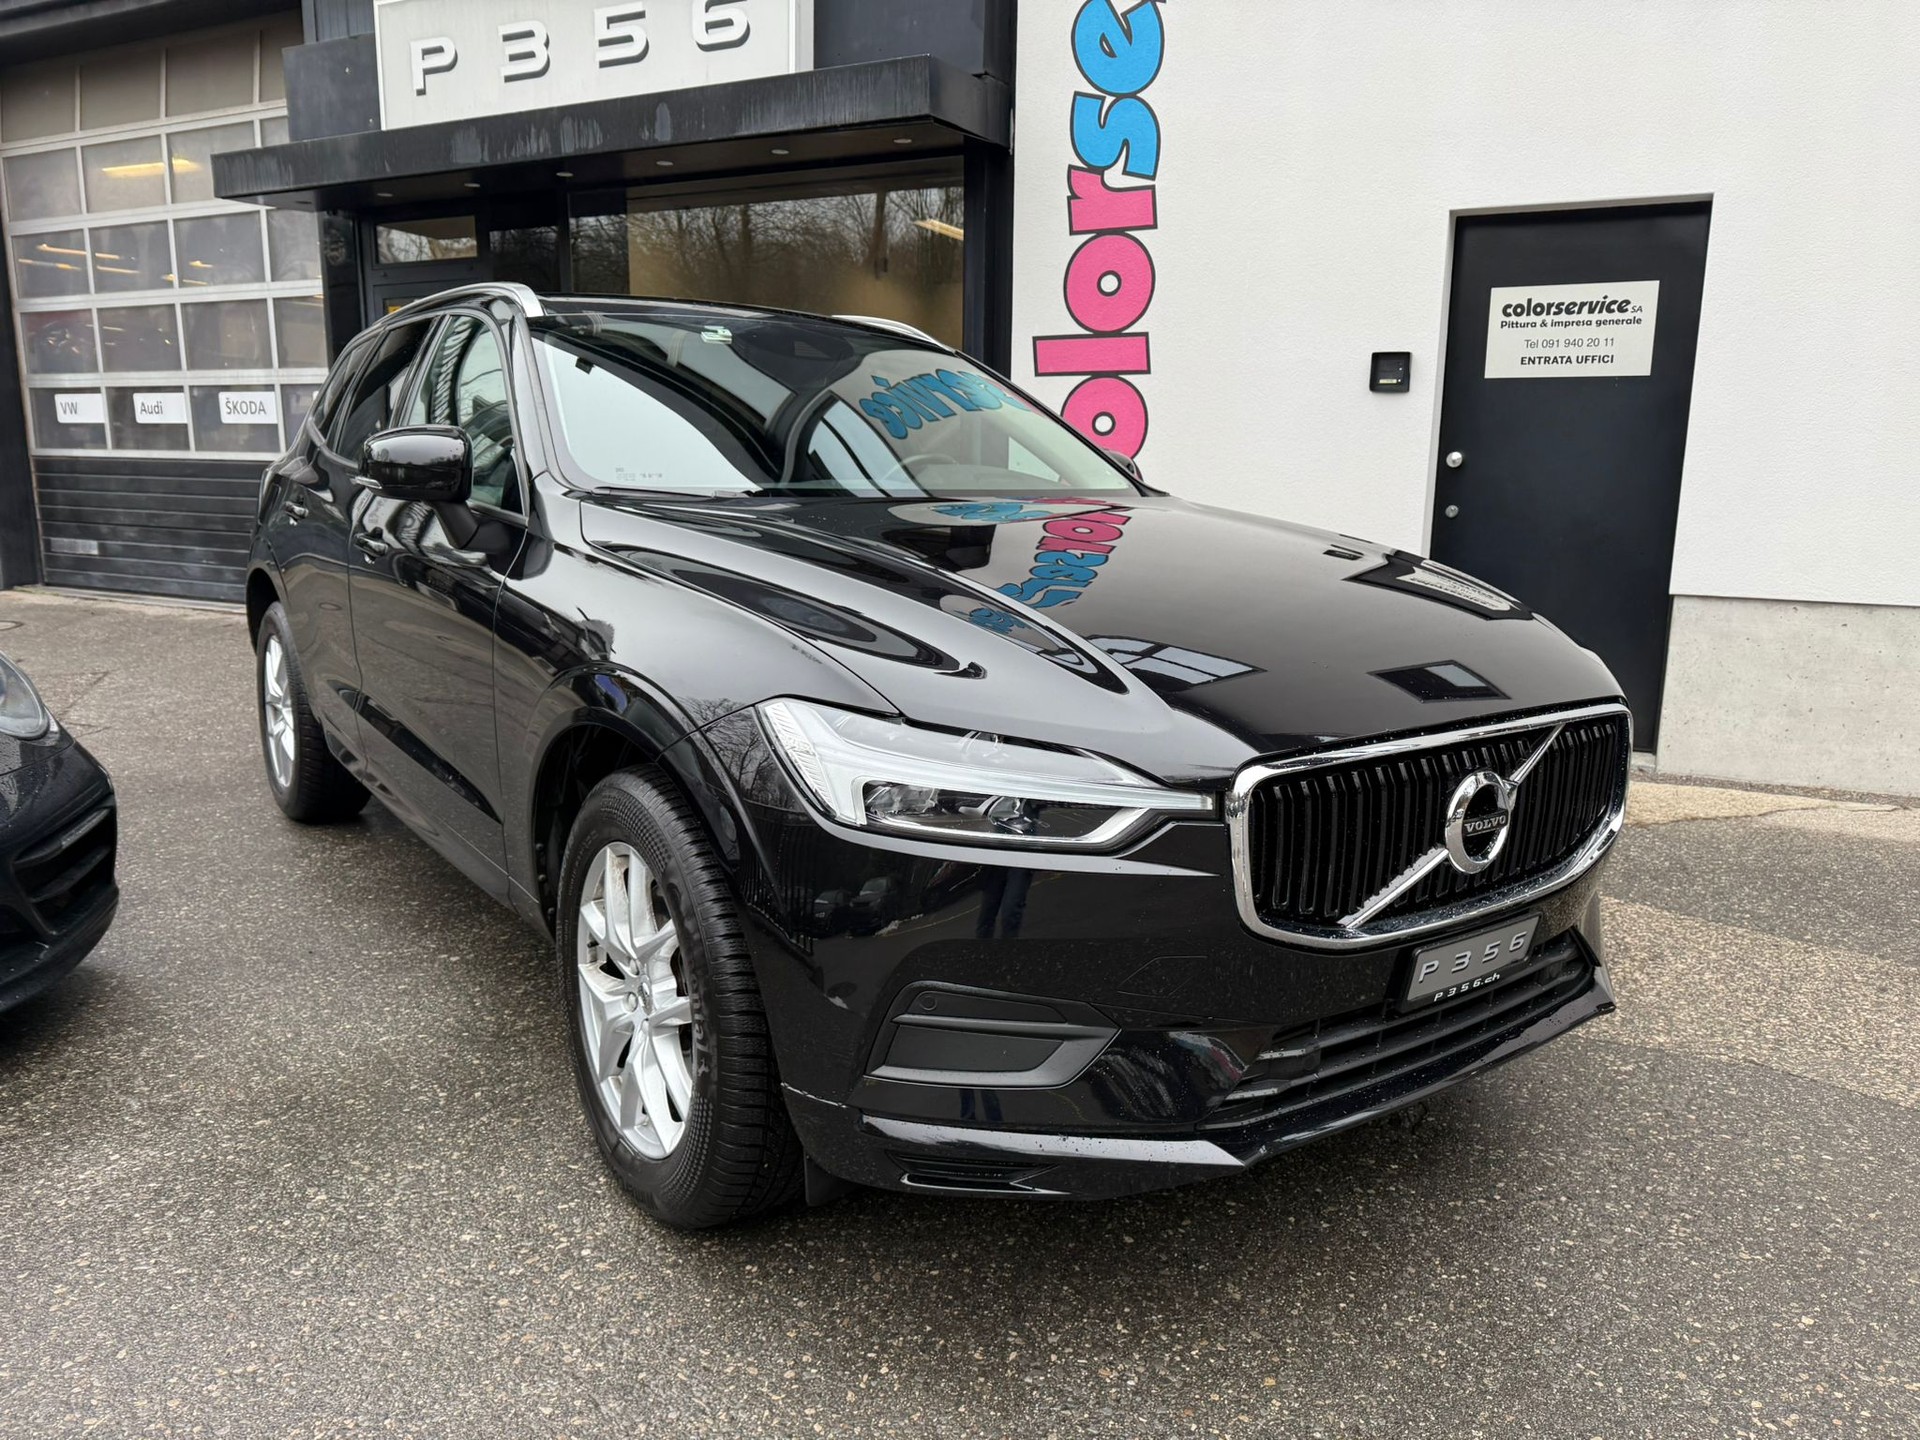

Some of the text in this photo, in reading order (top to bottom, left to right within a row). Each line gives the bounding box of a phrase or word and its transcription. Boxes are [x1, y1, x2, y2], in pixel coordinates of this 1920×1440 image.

[1032, 0, 1166, 480] olorse
[1502, 295, 1631, 317] colorservice
[1500, 316, 1642, 329] Pittura & impresa generale
[1524, 337, 1615, 349] Tel 091 940 20 11
[1520, 354, 1614, 365] ENTRATA UFFICI
[60, 402, 78, 415] VW
[140, 401, 163, 415] Audi
[225, 397, 267, 415] ŠKODA
[1464, 815, 1507, 833] VOLVO
